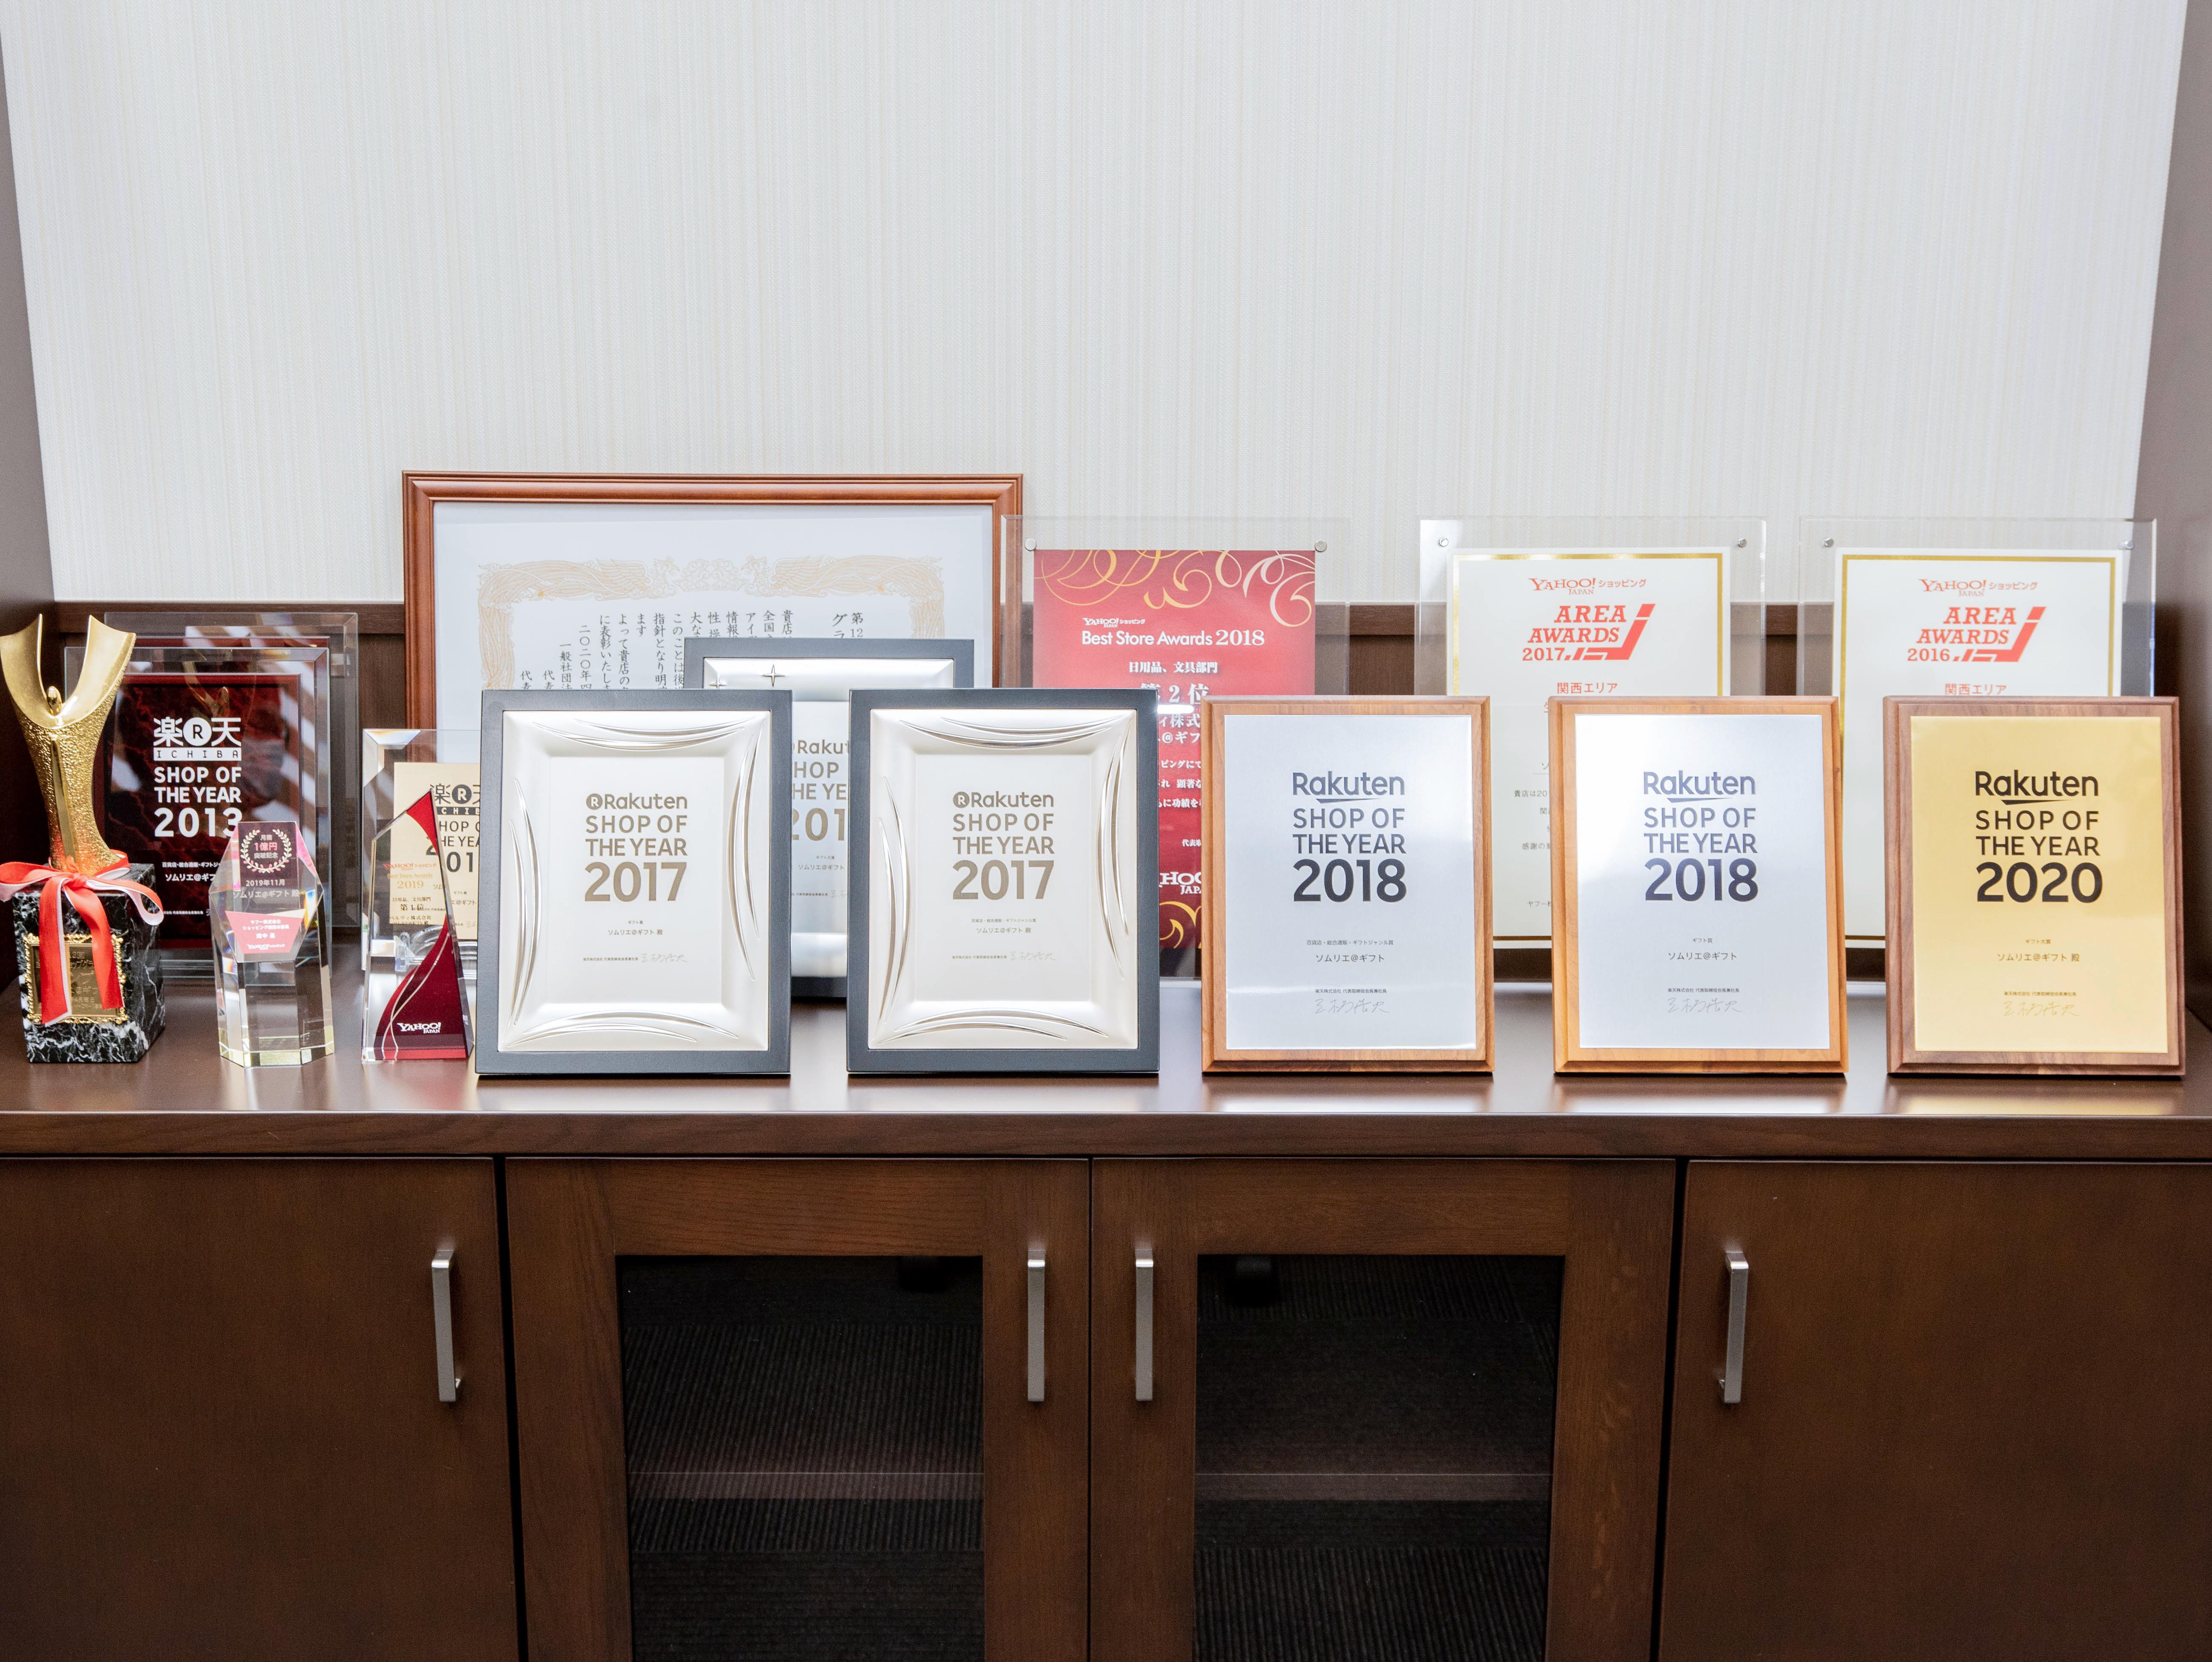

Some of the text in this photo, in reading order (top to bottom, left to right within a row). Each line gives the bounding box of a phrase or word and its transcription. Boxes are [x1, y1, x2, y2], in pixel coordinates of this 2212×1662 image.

[1598, 579, 1647, 587] ショッピング
[1989, 582, 2038, 590] ショッピング
[1554, 605, 1626, 623] AREA
[1944, 607, 2016, 624] AREA
[636, 614, 647, 636] ます
[691, 612, 702, 637] 大な
[726, 610, 739, 638] 情報
[746, 612, 758, 638] アイ
[763, 610, 775, 638] 全国
[782, 610, 793, 638] 貴店
[1082, 630, 1264, 646] Best Store Awards 2018
[1527, 627, 1619, 643] AWARDS
[1916, 629, 2009, 644] AWARDS
[618, 614, 630, 689] よって貴店の
[654, 613, 666, 689] 指針となり明
[673, 613, 684, 689] このことは後
[1522, 647, 1564, 661] 2017
[1907, 648, 1949, 661] 2016
[1557, 682, 1618, 694] 関西エリア
[1945, 684, 2007, 696] 関西エリア
[1159, 731, 1200, 744] @ギフ
[154, 767, 242, 783] SHOP OF
[794, 762, 839, 778] HOP
[1159, 779, 1170, 788] れ
[1293, 771, 1404, 796] Rakuten
[1643, 770, 1756, 795] Rakuten
[1975, 770, 2099, 797] Rakuten
[154, 787, 242, 803] THE YEAR
[605, 793, 688, 809] Rakuten
[793, 784, 847, 800] HE YE
[971, 791, 1054, 807] Rakuten
[1159, 798, 1201, 808] に功績を
[154, 807, 243, 837] 2013
[440, 821, 469, 832] HOP
[586, 815, 687, 833] SHOP OF
[793, 808, 845, 841] 01
[953, 813, 1054, 832] SHOP OF
[1293, 808, 1404, 829] SHOP OF
[1644, 807, 1756, 828] SHOP OF
[1976, 810, 2099, 830] SHOP OF
[254, 842, 277, 851] 1億円
[442, 836, 480, 847] HE YE
[585, 838, 688, 856] THE YEAR
[953, 836, 1055, 855] THE YEAR
[1293, 834, 1406, 854] THE YEAR
[1644, 833, 1758, 853] THE YEAR
[1976, 836, 2101, 856] THE YEAR
[397, 880, 424, 889] 2019
[585, 861, 687, 902] 2017
[953, 860, 1054, 900] 2017
[1159, 872, 1202, 887] HO
[1293, 858, 1407, 902] 2018
[1644, 858, 1758, 902] 2018
[1976, 862, 2103, 903] 2020
[1316, 954, 1384, 962] ソムリエ@ギフト
[1668, 952, 1737, 960] ソムリエ@ギフト
[1998, 953, 2080, 962] ソムリエ@ギフト 殿
[397, 1022, 441, 1032] YAHOO!
